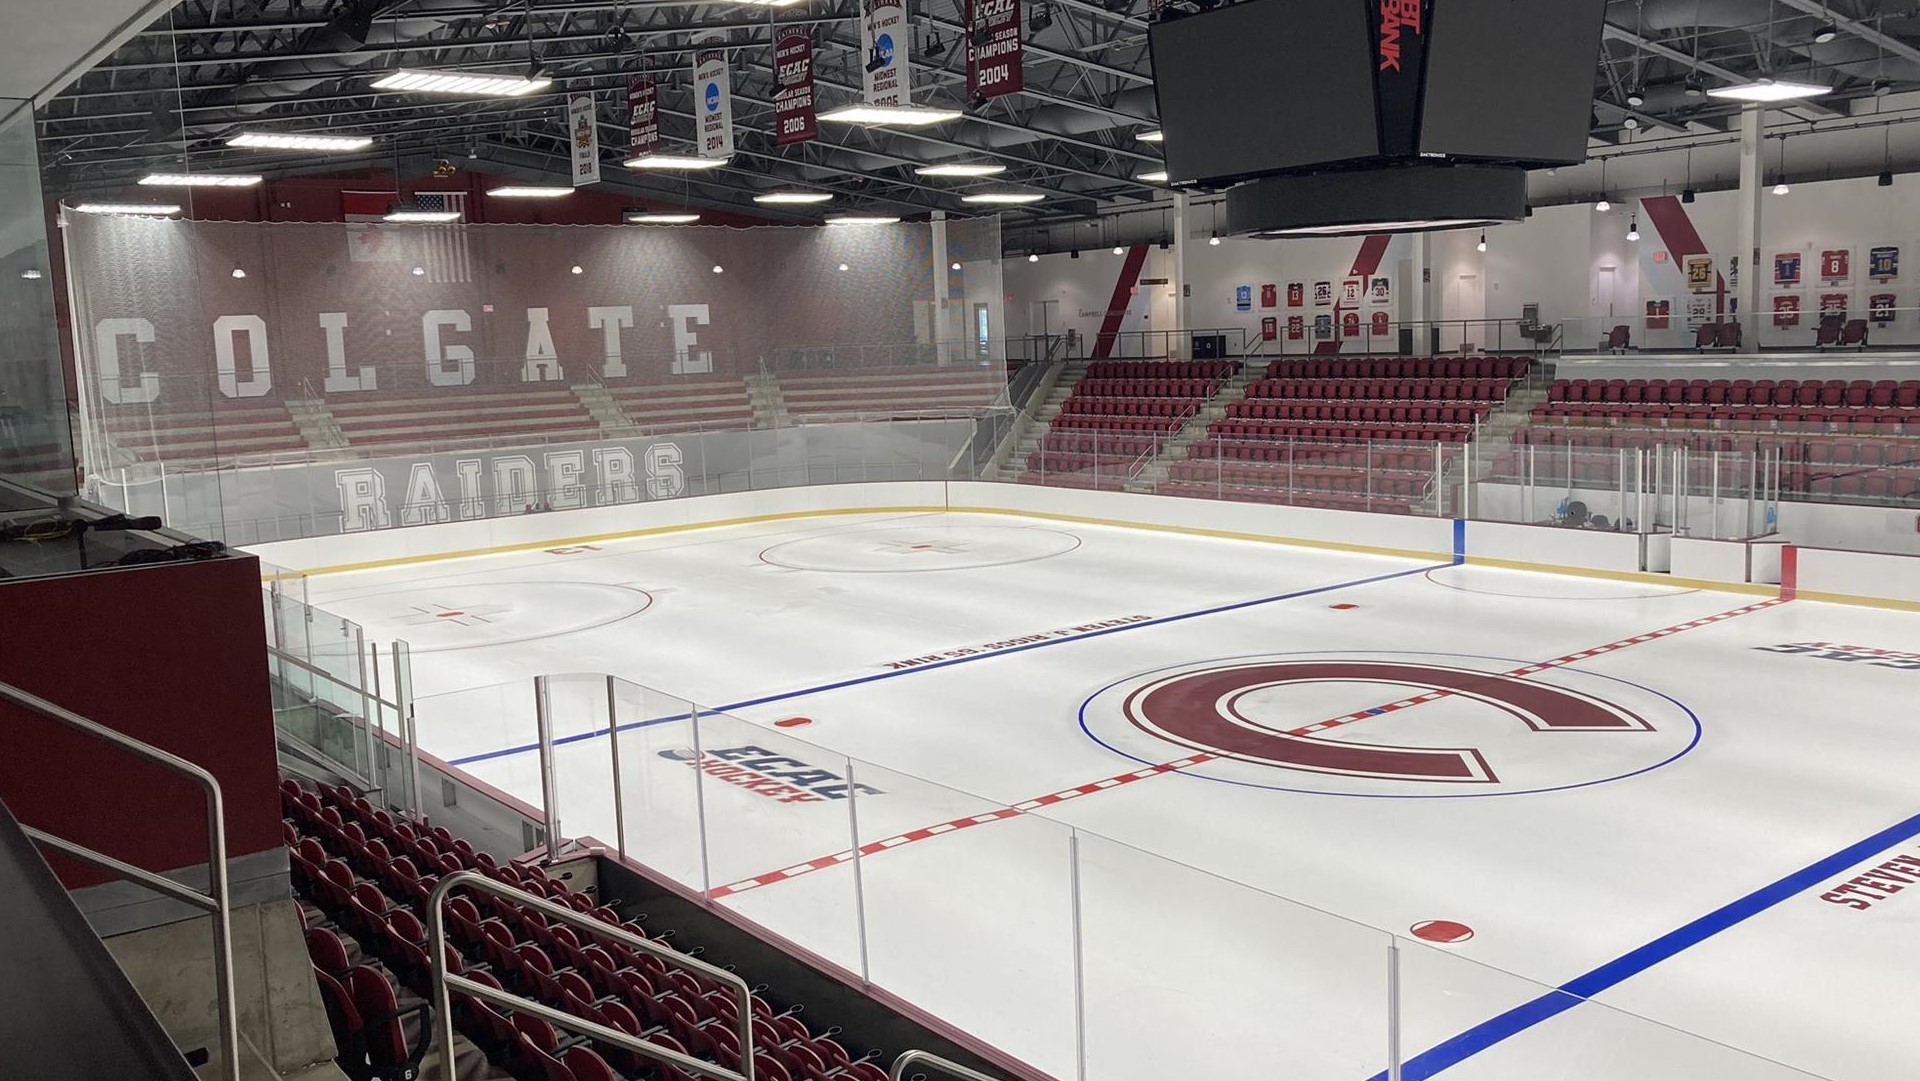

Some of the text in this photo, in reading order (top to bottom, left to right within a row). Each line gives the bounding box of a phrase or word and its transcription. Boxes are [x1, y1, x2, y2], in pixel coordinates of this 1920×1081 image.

[1380, 0, 1401, 72] BANK
[968, 38, 1019, 61] CHAMPIONS
[778, 58, 811, 78] ECAC
[979, 63, 1009, 86] 2004
[873, 79, 898, 92] REGIONAL
[776, 95, 812, 113] CHAMPIONS
[783, 116, 805, 134] 2006
[706, 135, 723, 150] 2014
[1831, 260, 1840, 273] 8
[95, 303, 713, 404] COLGATE
[335, 443, 685, 533] RAIDERS
[686, 759, 826, 804] HOCKEY
[706, 745, 889, 801] ECAC
